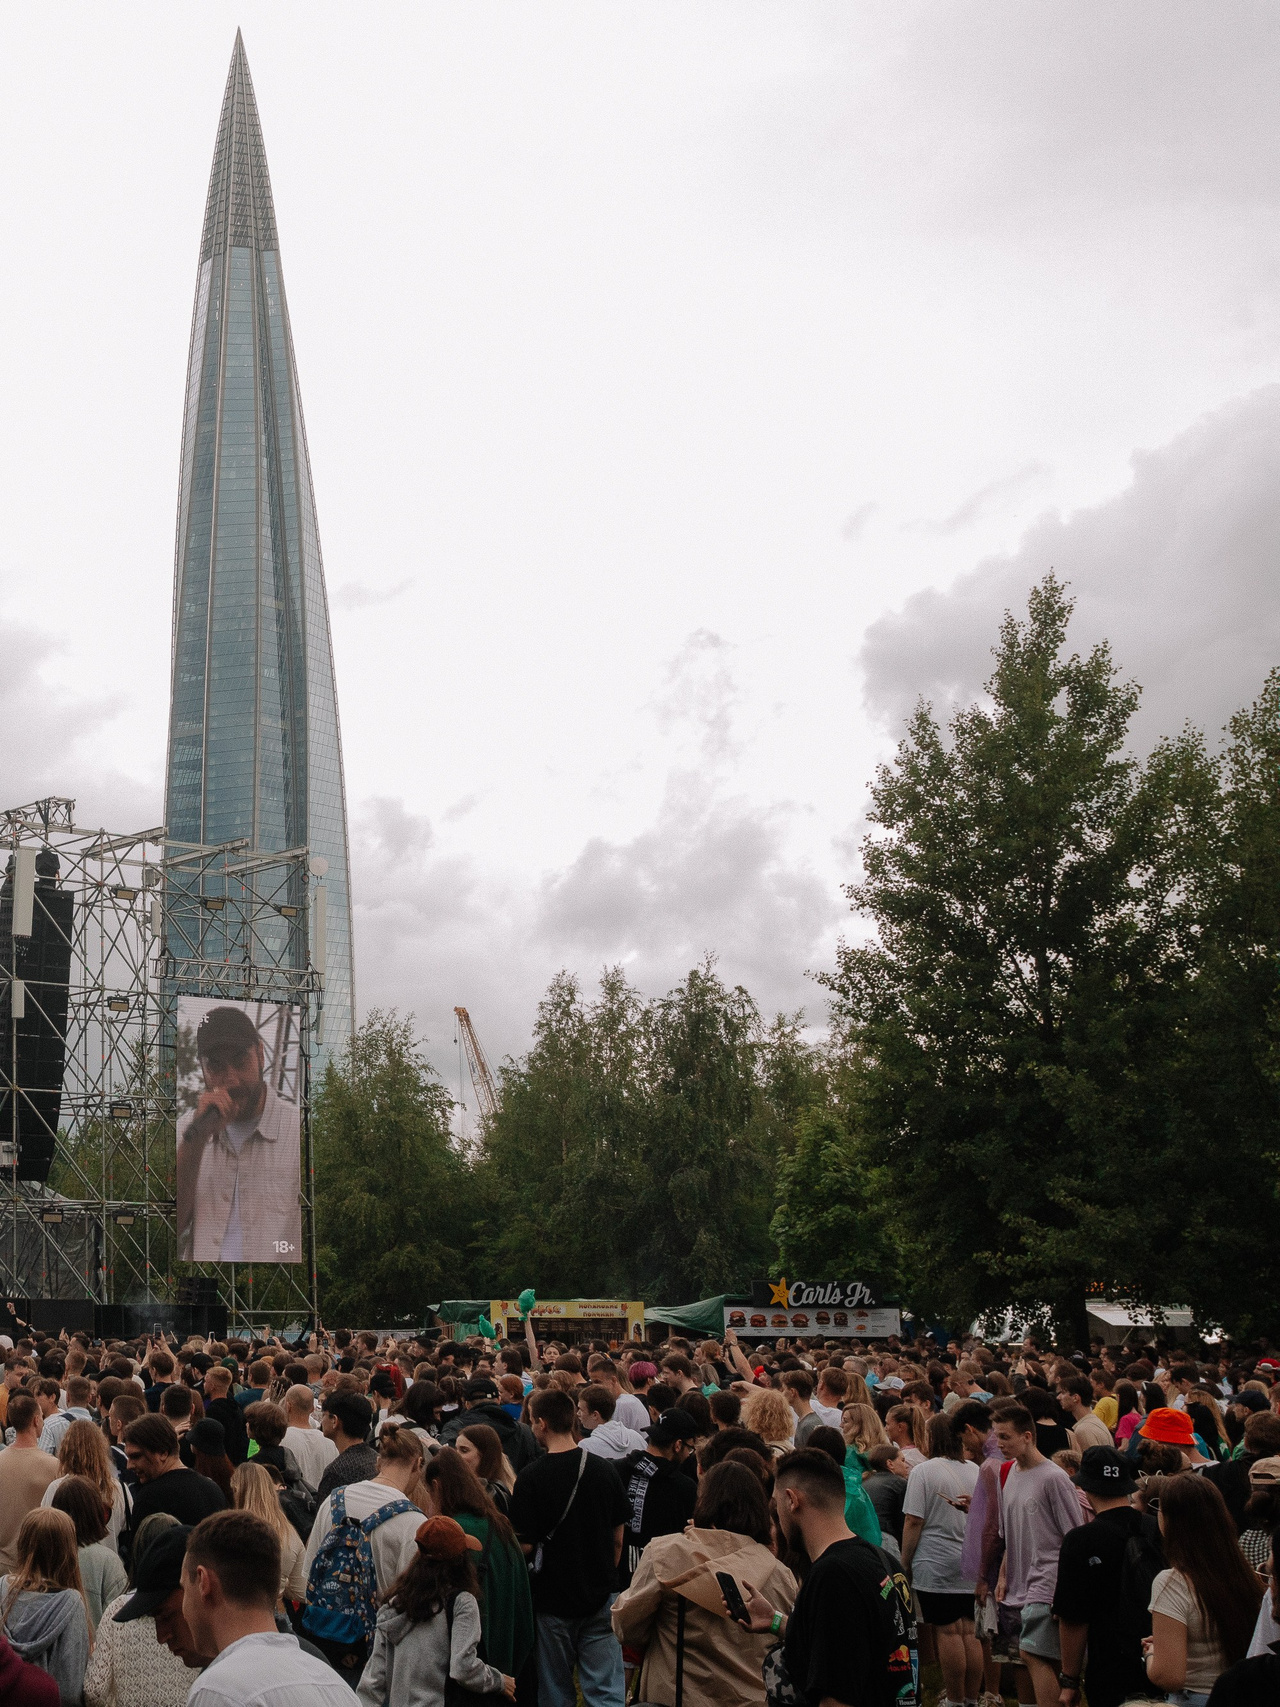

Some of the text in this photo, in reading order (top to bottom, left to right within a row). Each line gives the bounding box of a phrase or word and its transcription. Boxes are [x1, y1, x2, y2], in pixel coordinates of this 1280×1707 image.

[272, 1240, 295, 1253] 18+
[788, 1281, 876, 1308] Carl's Jr.
[1103, 1465, 1120, 1478] 23
